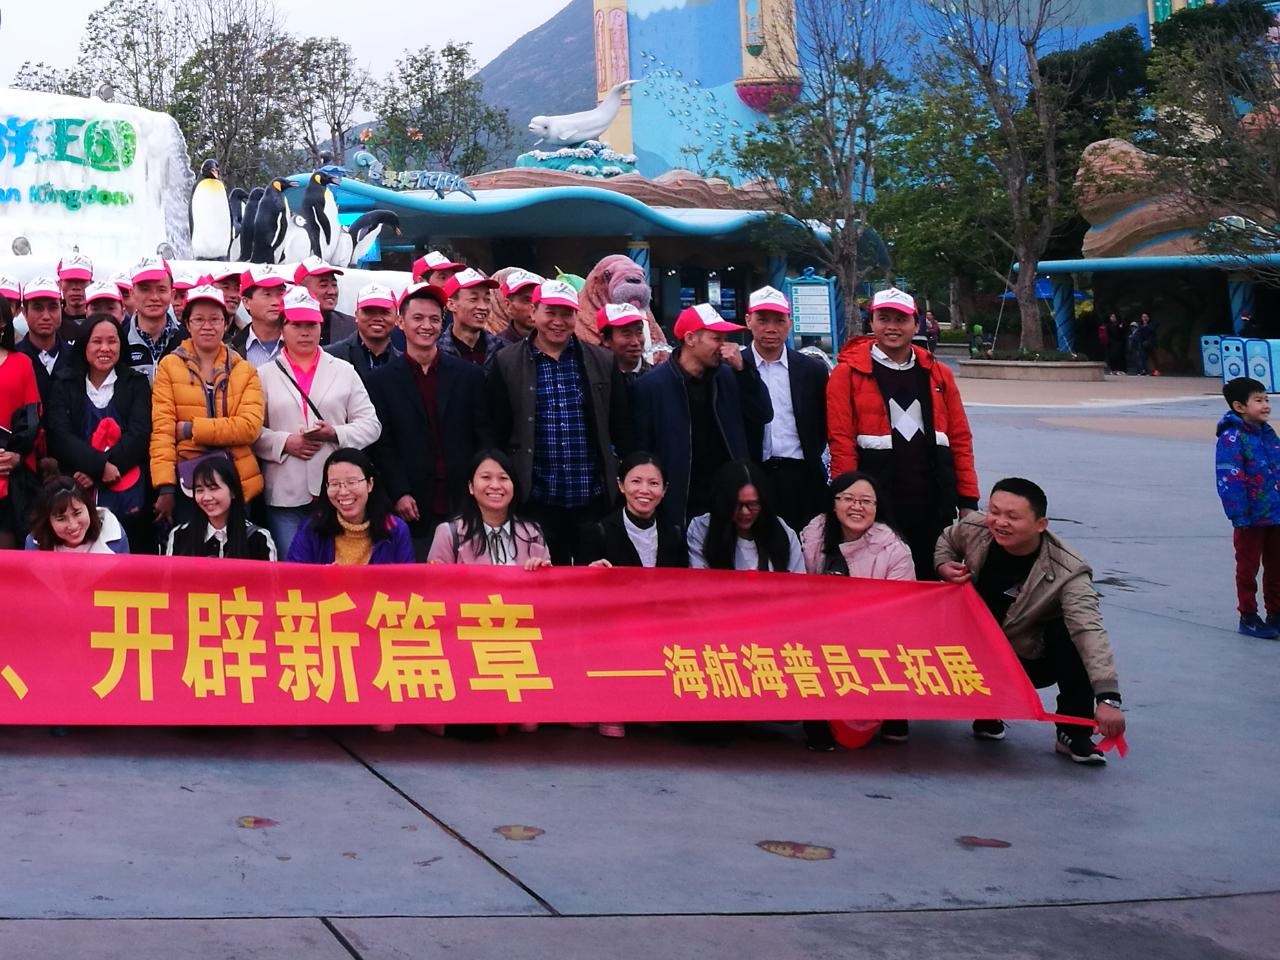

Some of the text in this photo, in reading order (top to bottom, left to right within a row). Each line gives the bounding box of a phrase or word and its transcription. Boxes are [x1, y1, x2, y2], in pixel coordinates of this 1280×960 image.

[28, 182, 134, 210] Kingdom
[90, 586, 554, 704] 开辟新篇章
